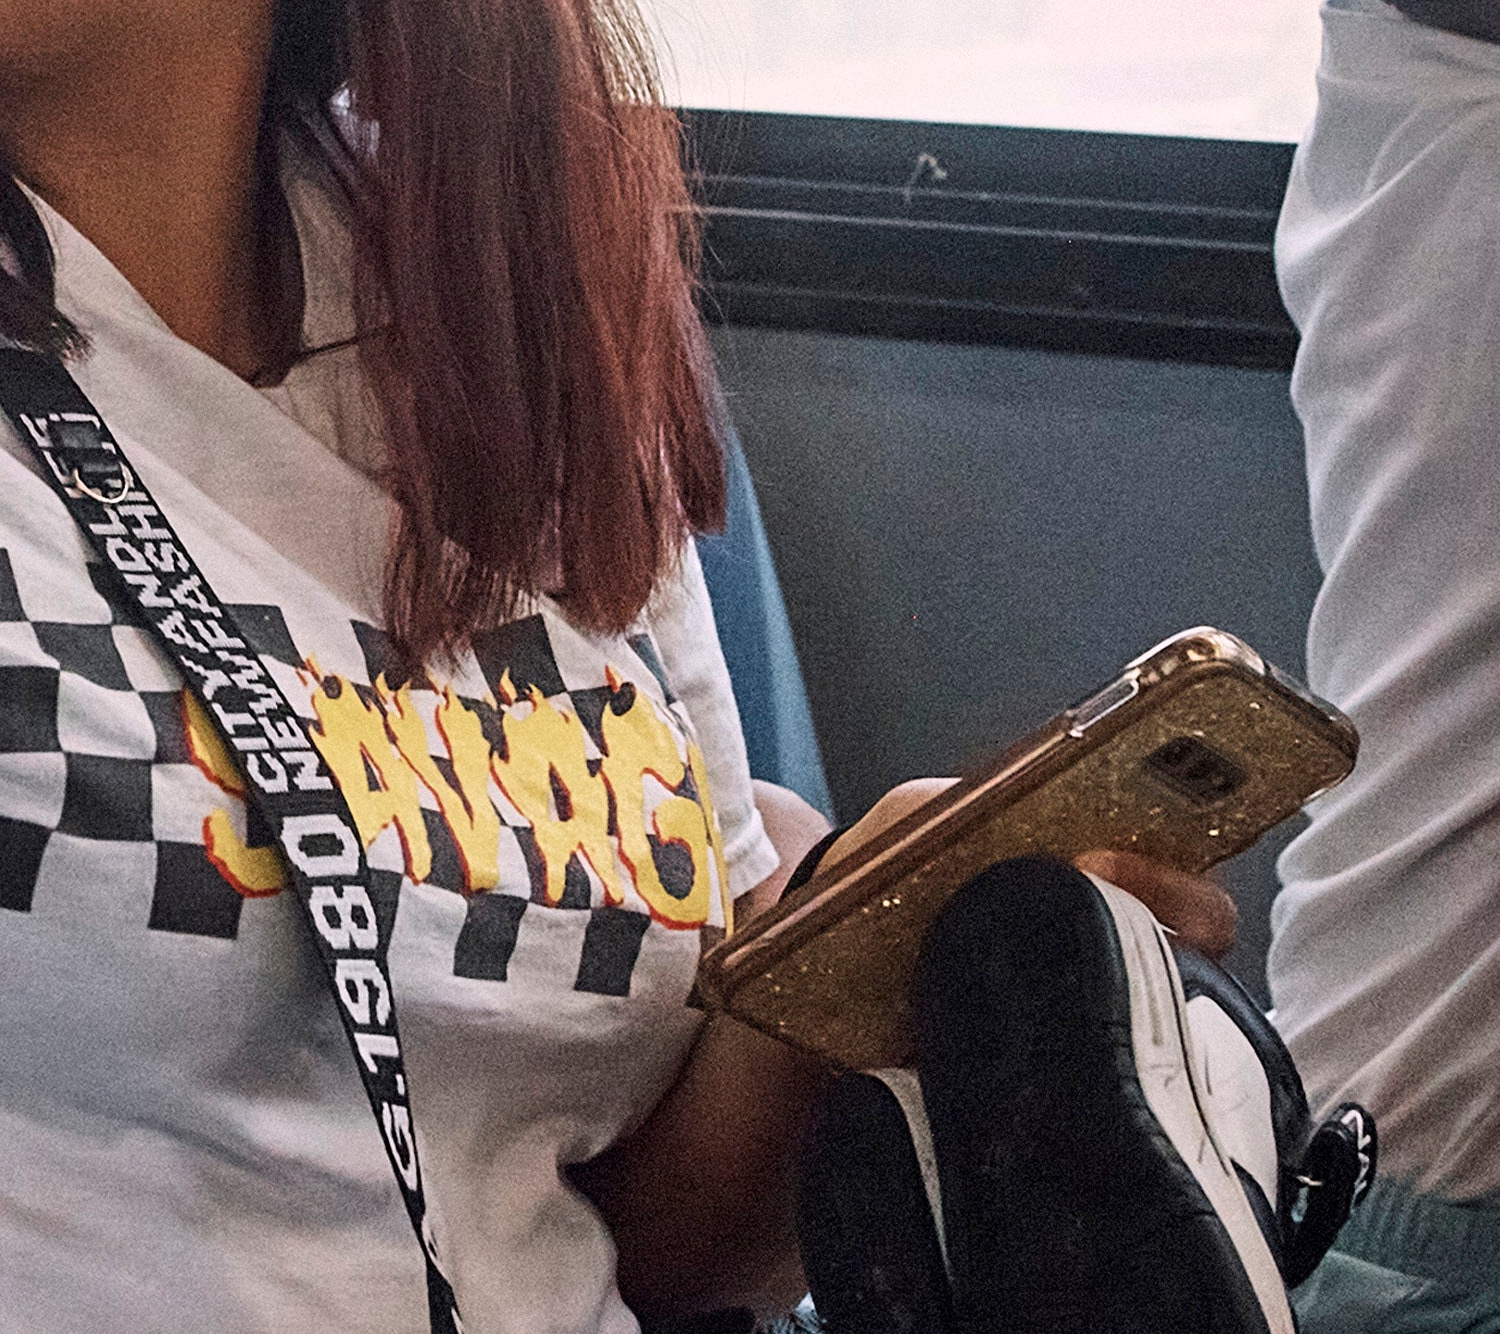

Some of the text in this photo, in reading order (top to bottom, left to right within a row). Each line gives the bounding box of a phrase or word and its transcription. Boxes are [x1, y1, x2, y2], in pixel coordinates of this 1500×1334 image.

[105, 535, 210, 655] AND
[180, 654, 288, 793] CITY
[214, 650, 334, 791] NEW
